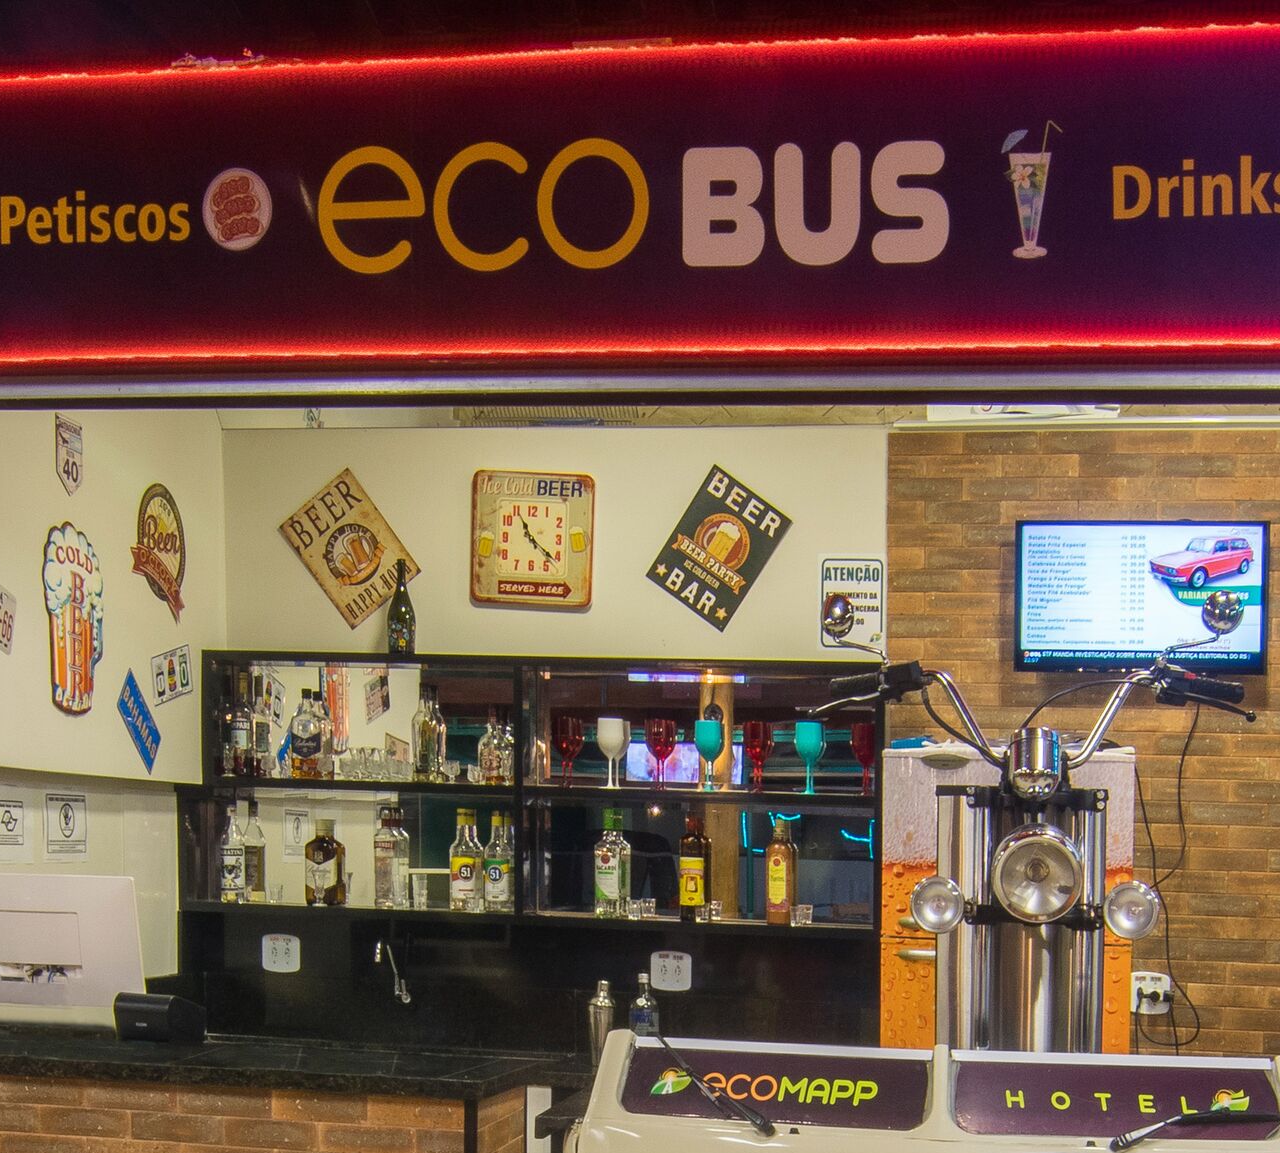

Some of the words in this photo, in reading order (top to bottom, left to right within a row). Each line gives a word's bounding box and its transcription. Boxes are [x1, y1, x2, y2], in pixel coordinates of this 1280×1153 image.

[320, 138, 650, 274] eco
[682, 140, 950, 267] BUS
[0, 190, 192, 246] Petiscos
[63, 459, 79, 483] 40
[482, 476, 500, 494] Ice
[504, 477, 534, 495] Cold
[537, 480, 583, 498] BEER
[289, 480, 363, 550] BEER
[528, 506, 538, 517] 12
[545, 506, 549, 517] 1
[707, 471, 782, 538] BEER
[503, 515, 512, 526] 10
[556, 518, 563, 528] 2
[143, 514, 180, 555] Beer
[502, 532, 509, 543] 9
[556, 535, 562, 545] 3
[55, 545, 93, 575] COLD
[502, 549, 508, 560] 8
[514, 560, 520, 570] 7
[680, 538, 707, 564] BEER
[706, 557, 742, 586] PARTY
[528, 560, 534, 571] 6
[543, 561, 549, 572] 5
[683, 559, 695, 571] ICE
[705, 574, 720, 589] BEER
[824, 564, 880, 584] ATENÇÃO
[500, 583, 535, 593] SERVED
[538, 585, 564, 594] HERE
[665, 567, 716, 615] BAR
[869, 592, 878, 600] DA
[345, 582, 383, 620] HAPPY
[69, 570, 85, 702] BEER
[123, 686, 156, 759] BAHAMAS
[461, 867, 471, 877] 51
[490, 869, 500, 879] 51
[1006, 1088, 1197, 1115] HOTEL
